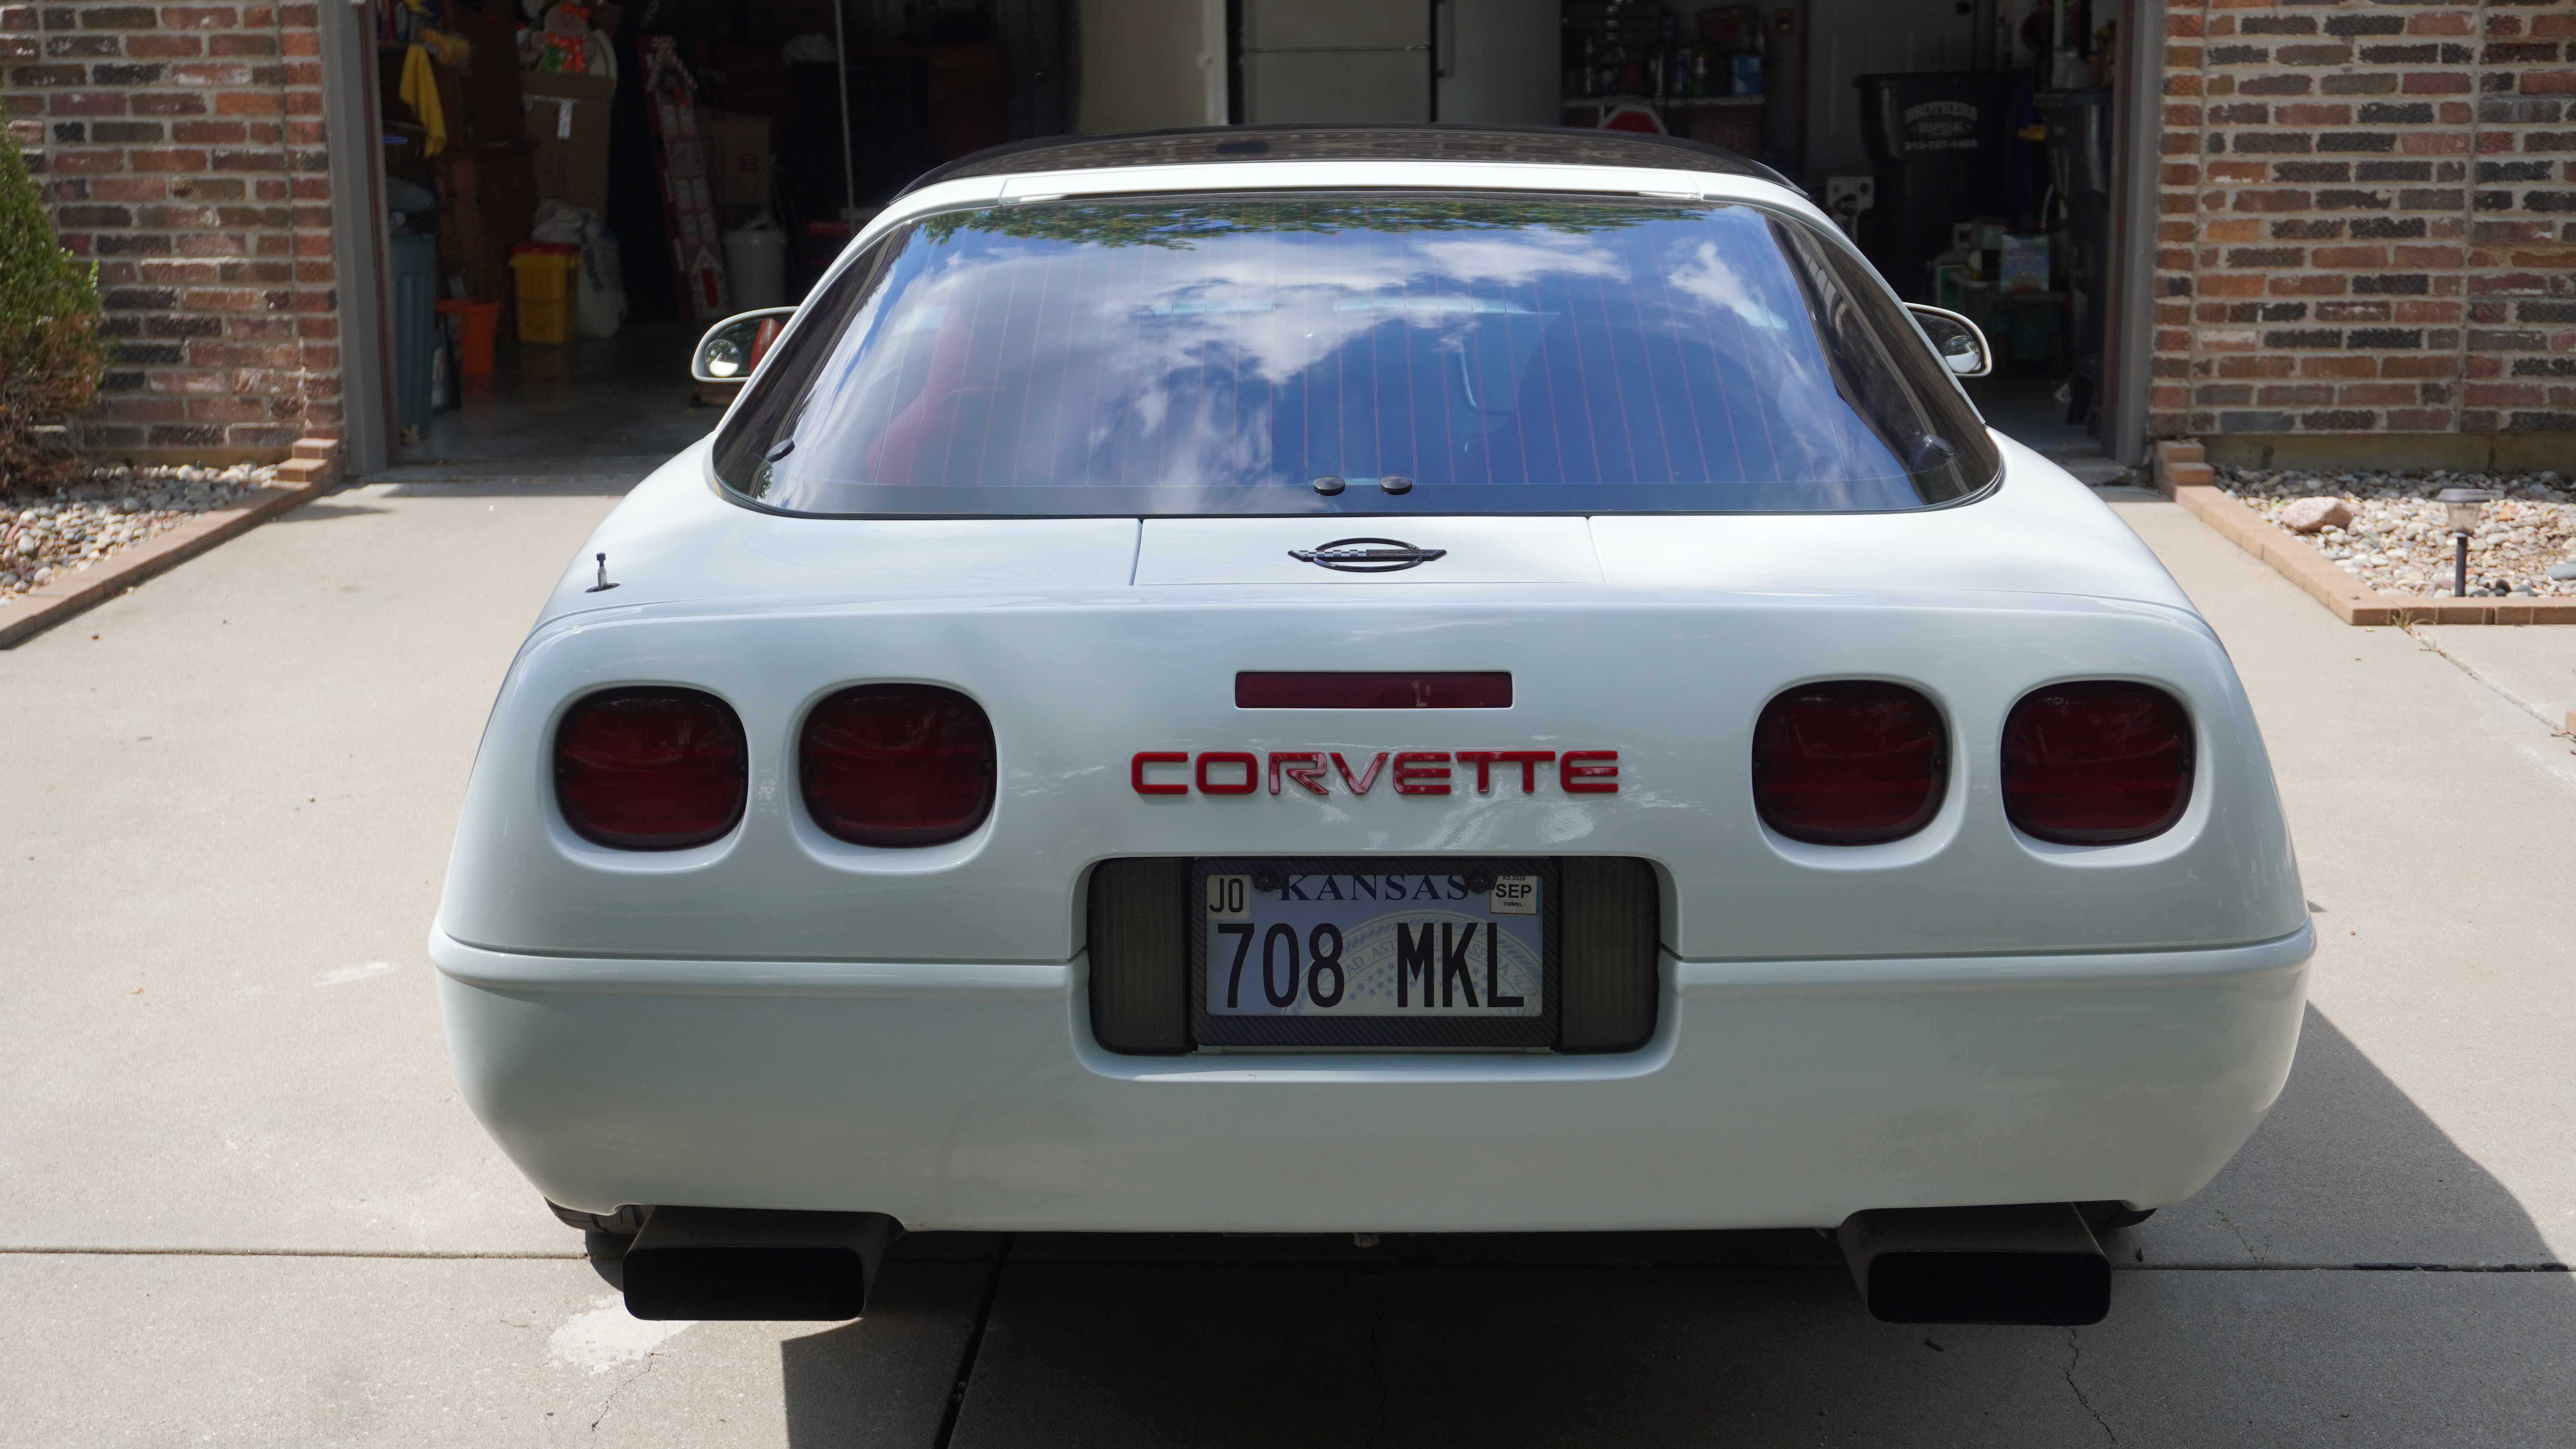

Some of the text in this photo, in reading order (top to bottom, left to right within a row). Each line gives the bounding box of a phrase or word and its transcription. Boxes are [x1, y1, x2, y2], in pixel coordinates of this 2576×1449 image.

[1904, 100, 1978, 124] BROTHERS
[1918, 121, 1965, 133] DISPOSAL
[1131, 751, 1618, 794] CORVETTE
[1209, 879, 1243, 912] JO
[1278, 875, 1469, 900] KANSAS
[1495, 883, 1532, 898] SEP
[1218, 923, 1524, 1008] 708 MKL
[1345, 956, 1364, 976] AD
